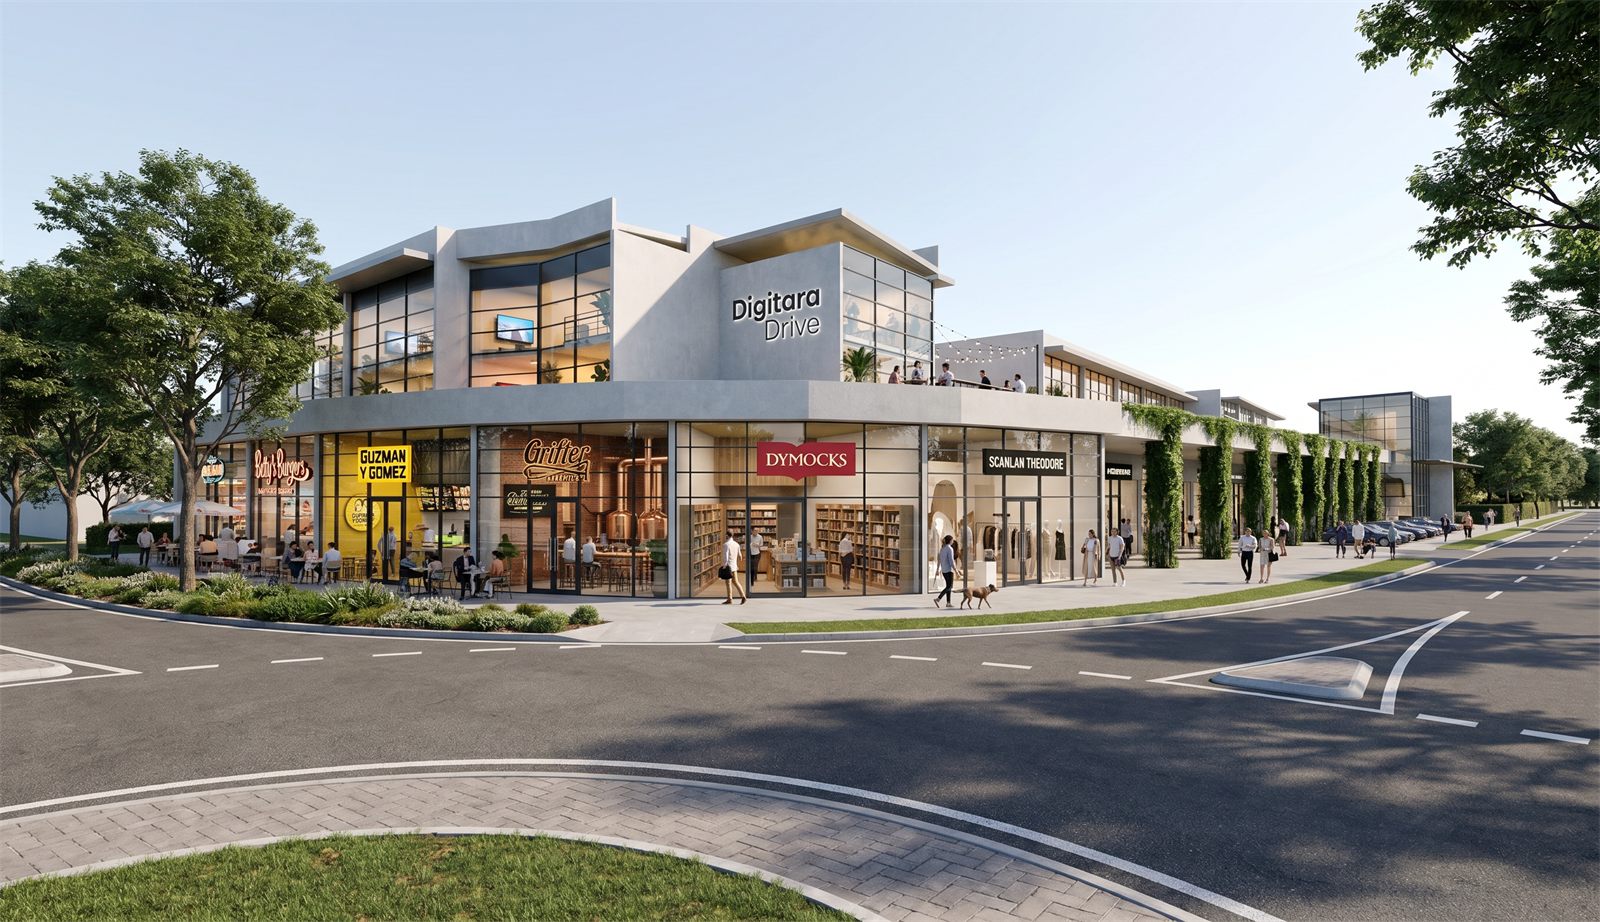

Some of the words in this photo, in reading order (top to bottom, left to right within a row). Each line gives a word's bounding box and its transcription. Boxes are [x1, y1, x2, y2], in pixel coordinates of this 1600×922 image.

[733, 288, 820, 321] Digitara
[765, 315, 820, 341] Drive
[360, 449, 406, 464] GUZMAN
[524, 438, 591, 465] Grifter
[766, 453, 847, 468] DYMOCKS
[254, 449, 277, 486] Betty's
[276, 448, 310, 486] Burgers
[360, 466, 367, 480] Y
[369, 465, 406, 480] GOMEZ
[989, 455, 1025, 469] SCANLAN
[1026, 457, 1064, 470] THEODORE
